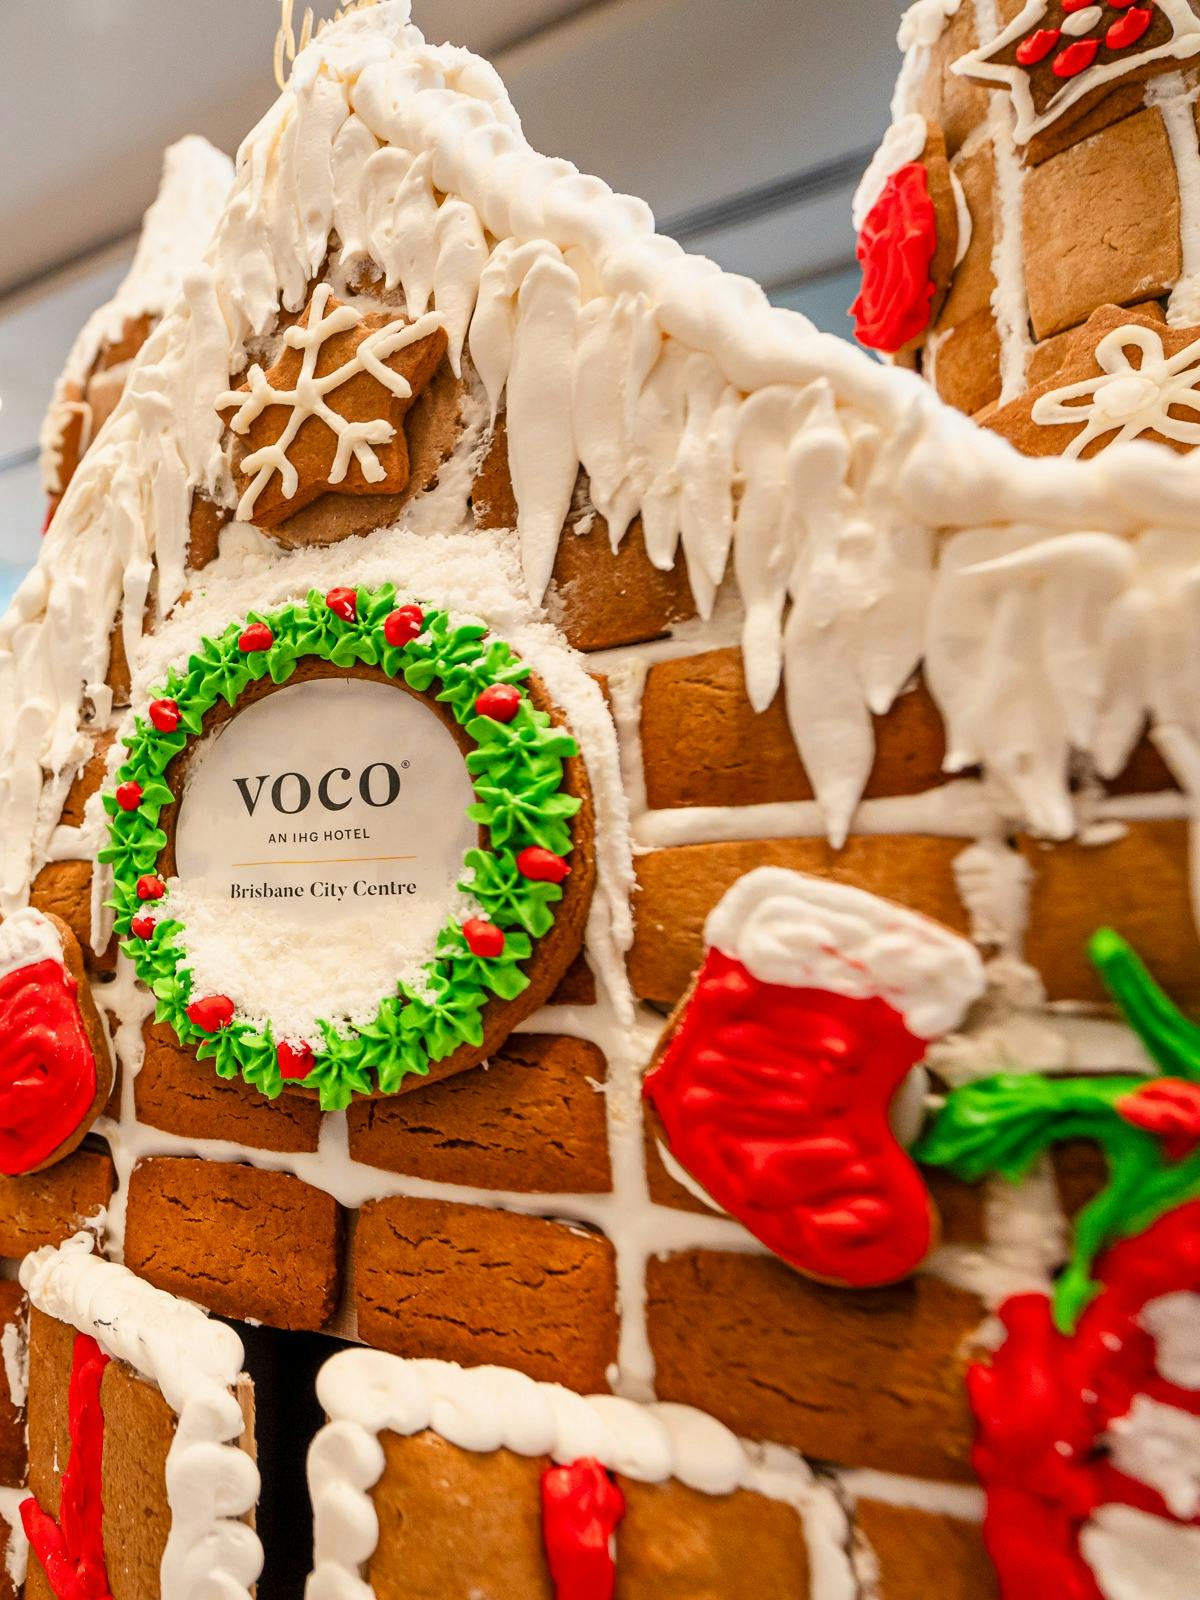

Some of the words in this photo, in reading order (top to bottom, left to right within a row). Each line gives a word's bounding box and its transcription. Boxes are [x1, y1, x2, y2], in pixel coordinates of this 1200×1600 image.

[267, 832, 288, 844] AN
[292, 831, 319, 843] IHG
[323, 827, 371, 841] HOTEL
[230, 882, 304, 900] Brisbane
[310, 880, 348, 902] City
[352, 879, 417, 897] Centre
